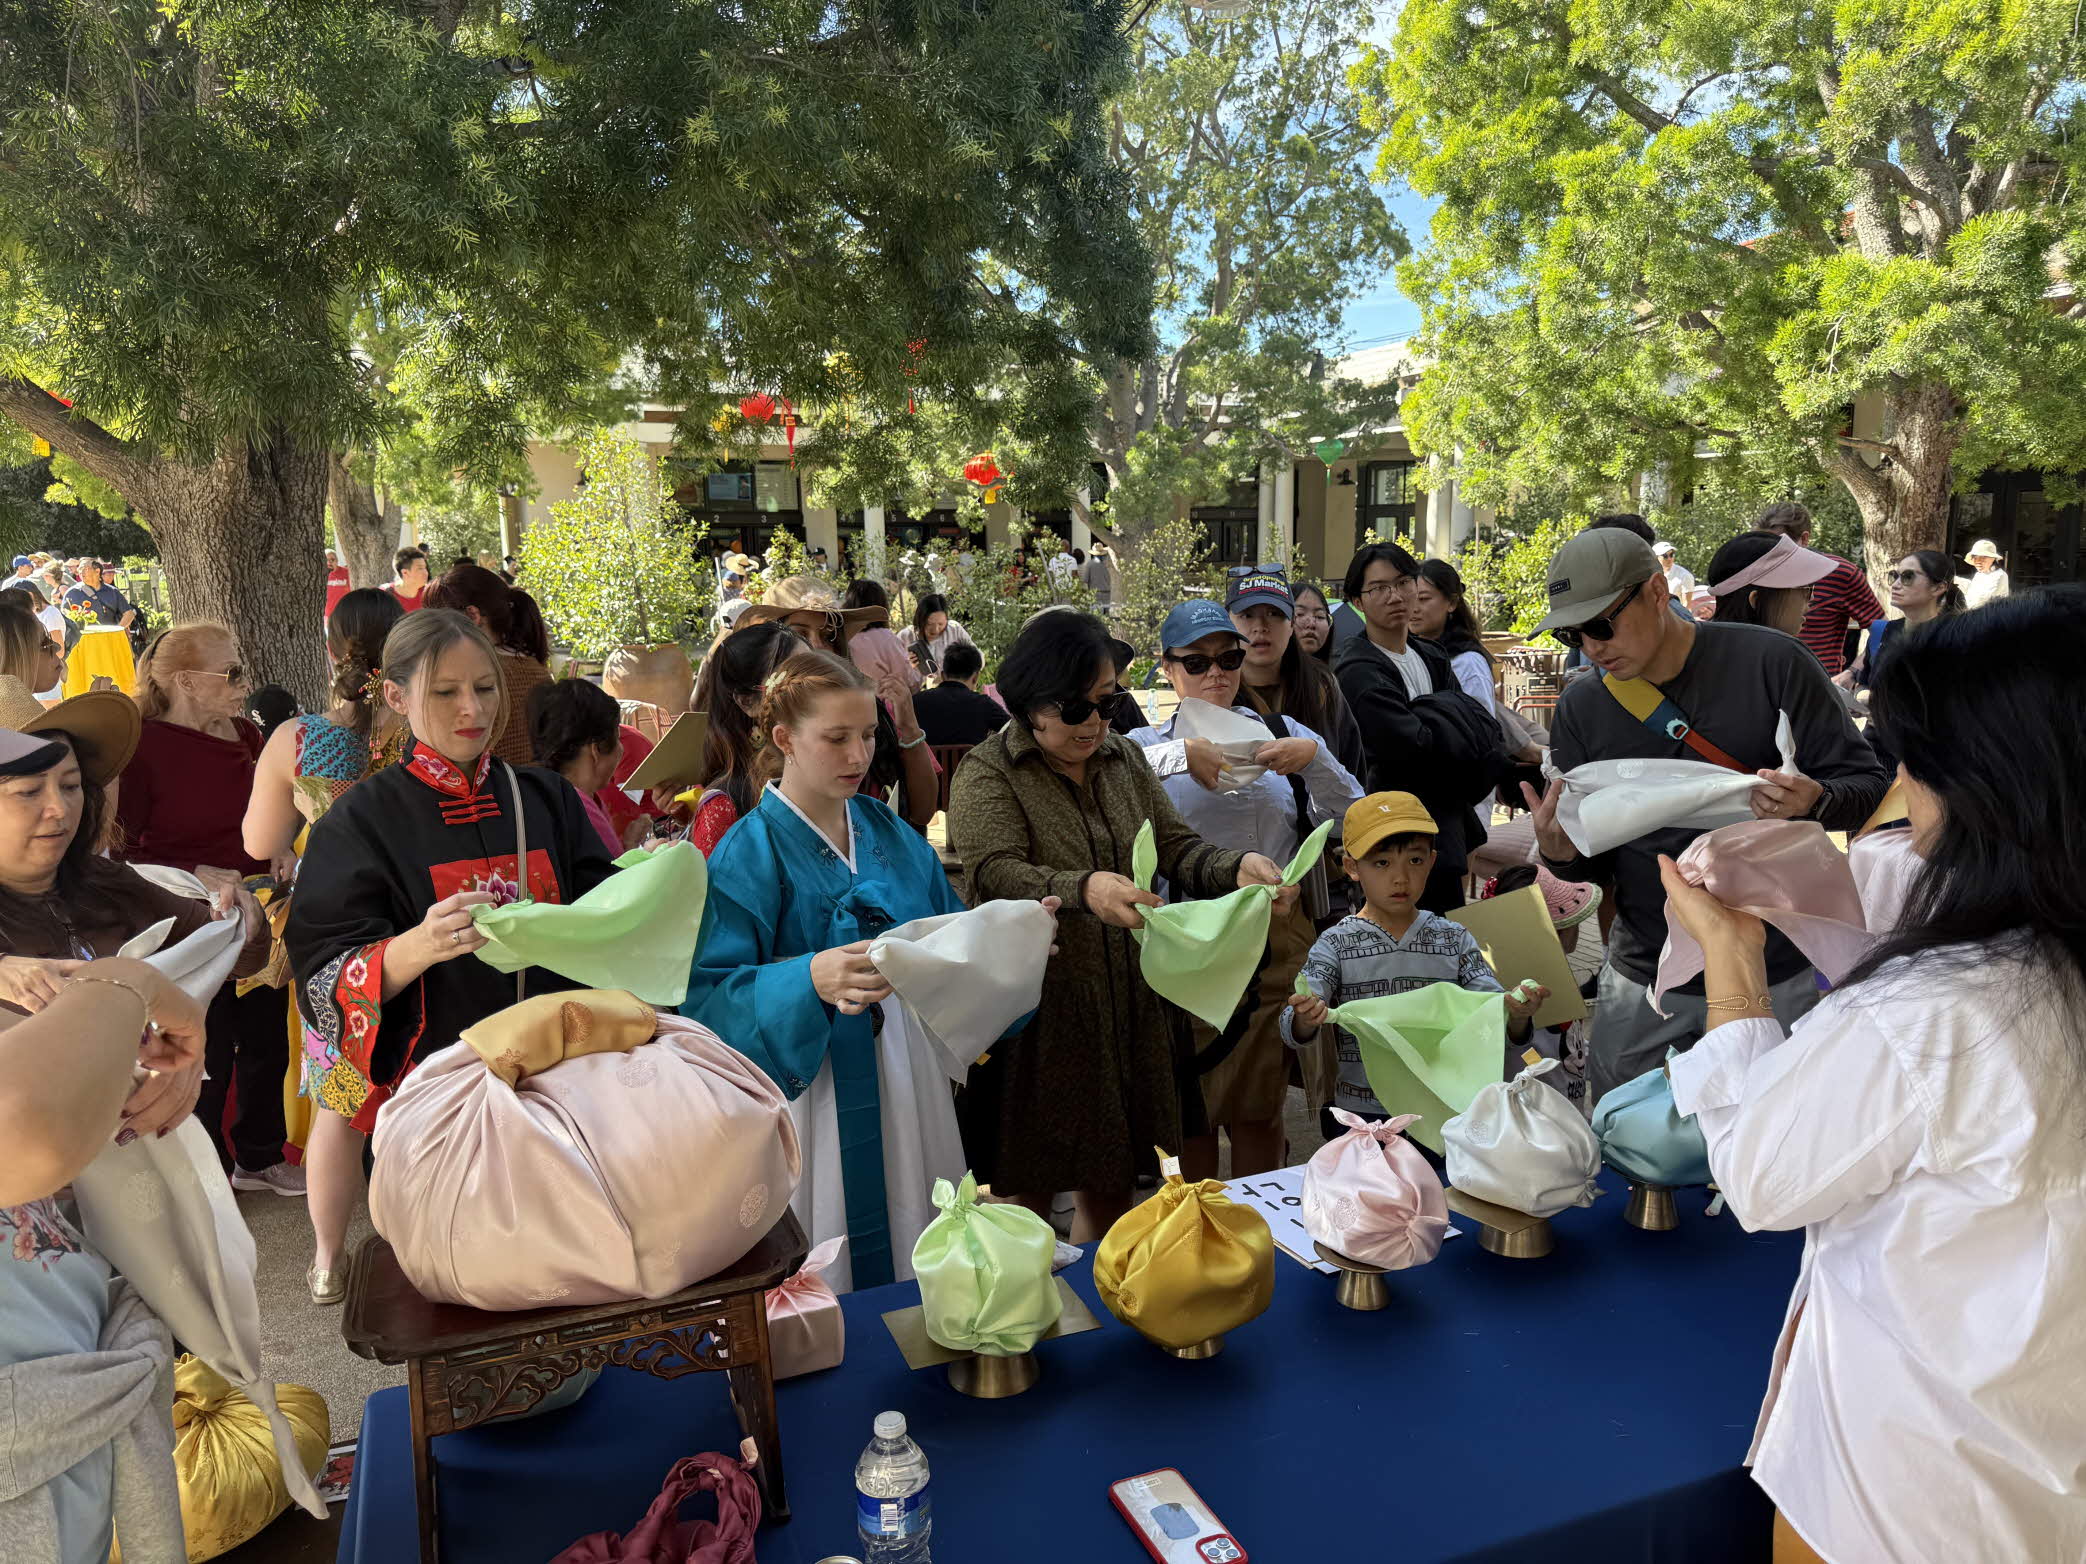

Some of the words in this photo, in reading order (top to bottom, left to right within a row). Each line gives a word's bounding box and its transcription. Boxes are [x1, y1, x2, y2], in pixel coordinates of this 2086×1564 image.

[713, 514, 721, 524] 2
[761, 514, 768, 524] 3
[891, 514, 897, 522] 5
[939, 513, 945, 522] 6
[1239, 579, 1253, 590] SJ
[1254, 579, 1289, 594] Market
